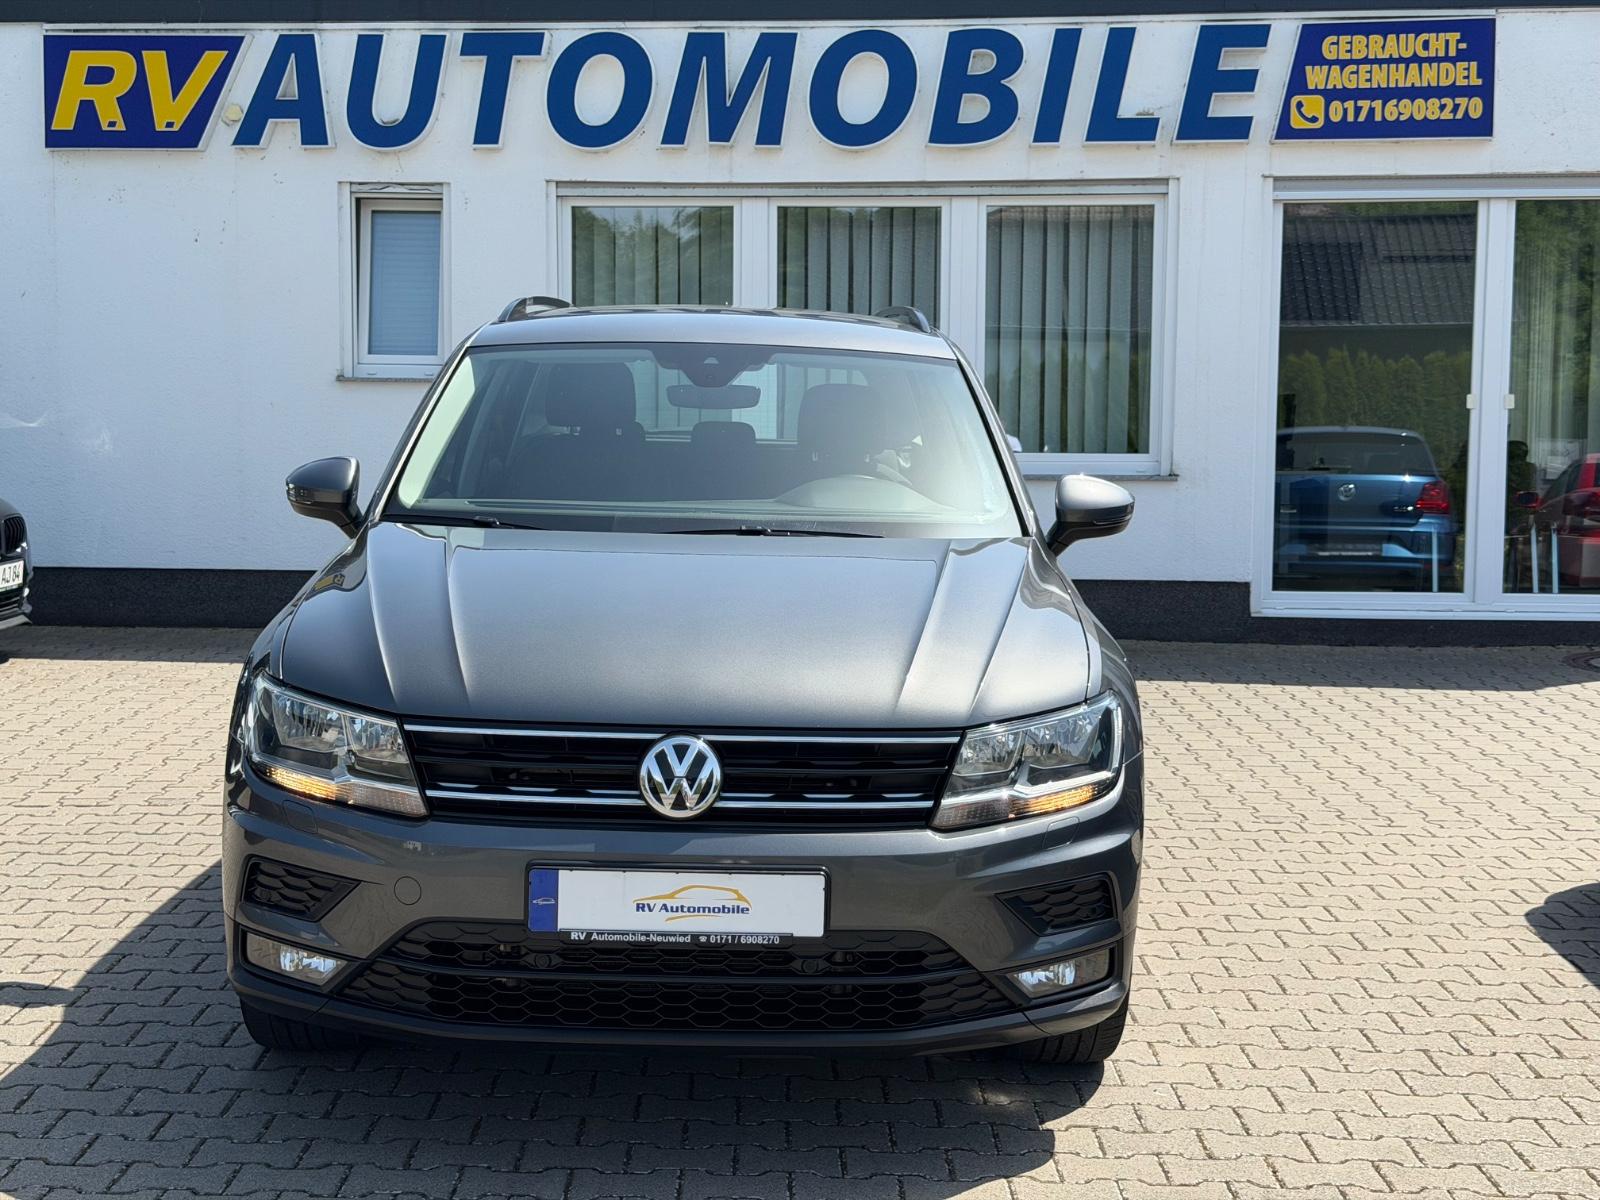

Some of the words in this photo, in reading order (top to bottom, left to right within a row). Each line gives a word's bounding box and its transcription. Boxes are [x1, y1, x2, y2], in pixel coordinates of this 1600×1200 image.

[1321, 32, 1468, 60] GEBRAUCHT-
[232, 24, 1272, 151] AUTOMOBILE
[1305, 61, 1483, 90] WAGENHANDEL
[1328, 97, 1484, 123] 01716908270
[635, 902, 656, 913] RV
[659, 903, 750, 914] Automobile
[570, 931, 587, 940] RV
[591, 932, 691, 943] Automobile-Neuwied
[710, 935, 732, 943] 0171
[740, 935, 780, 944] 6908270
